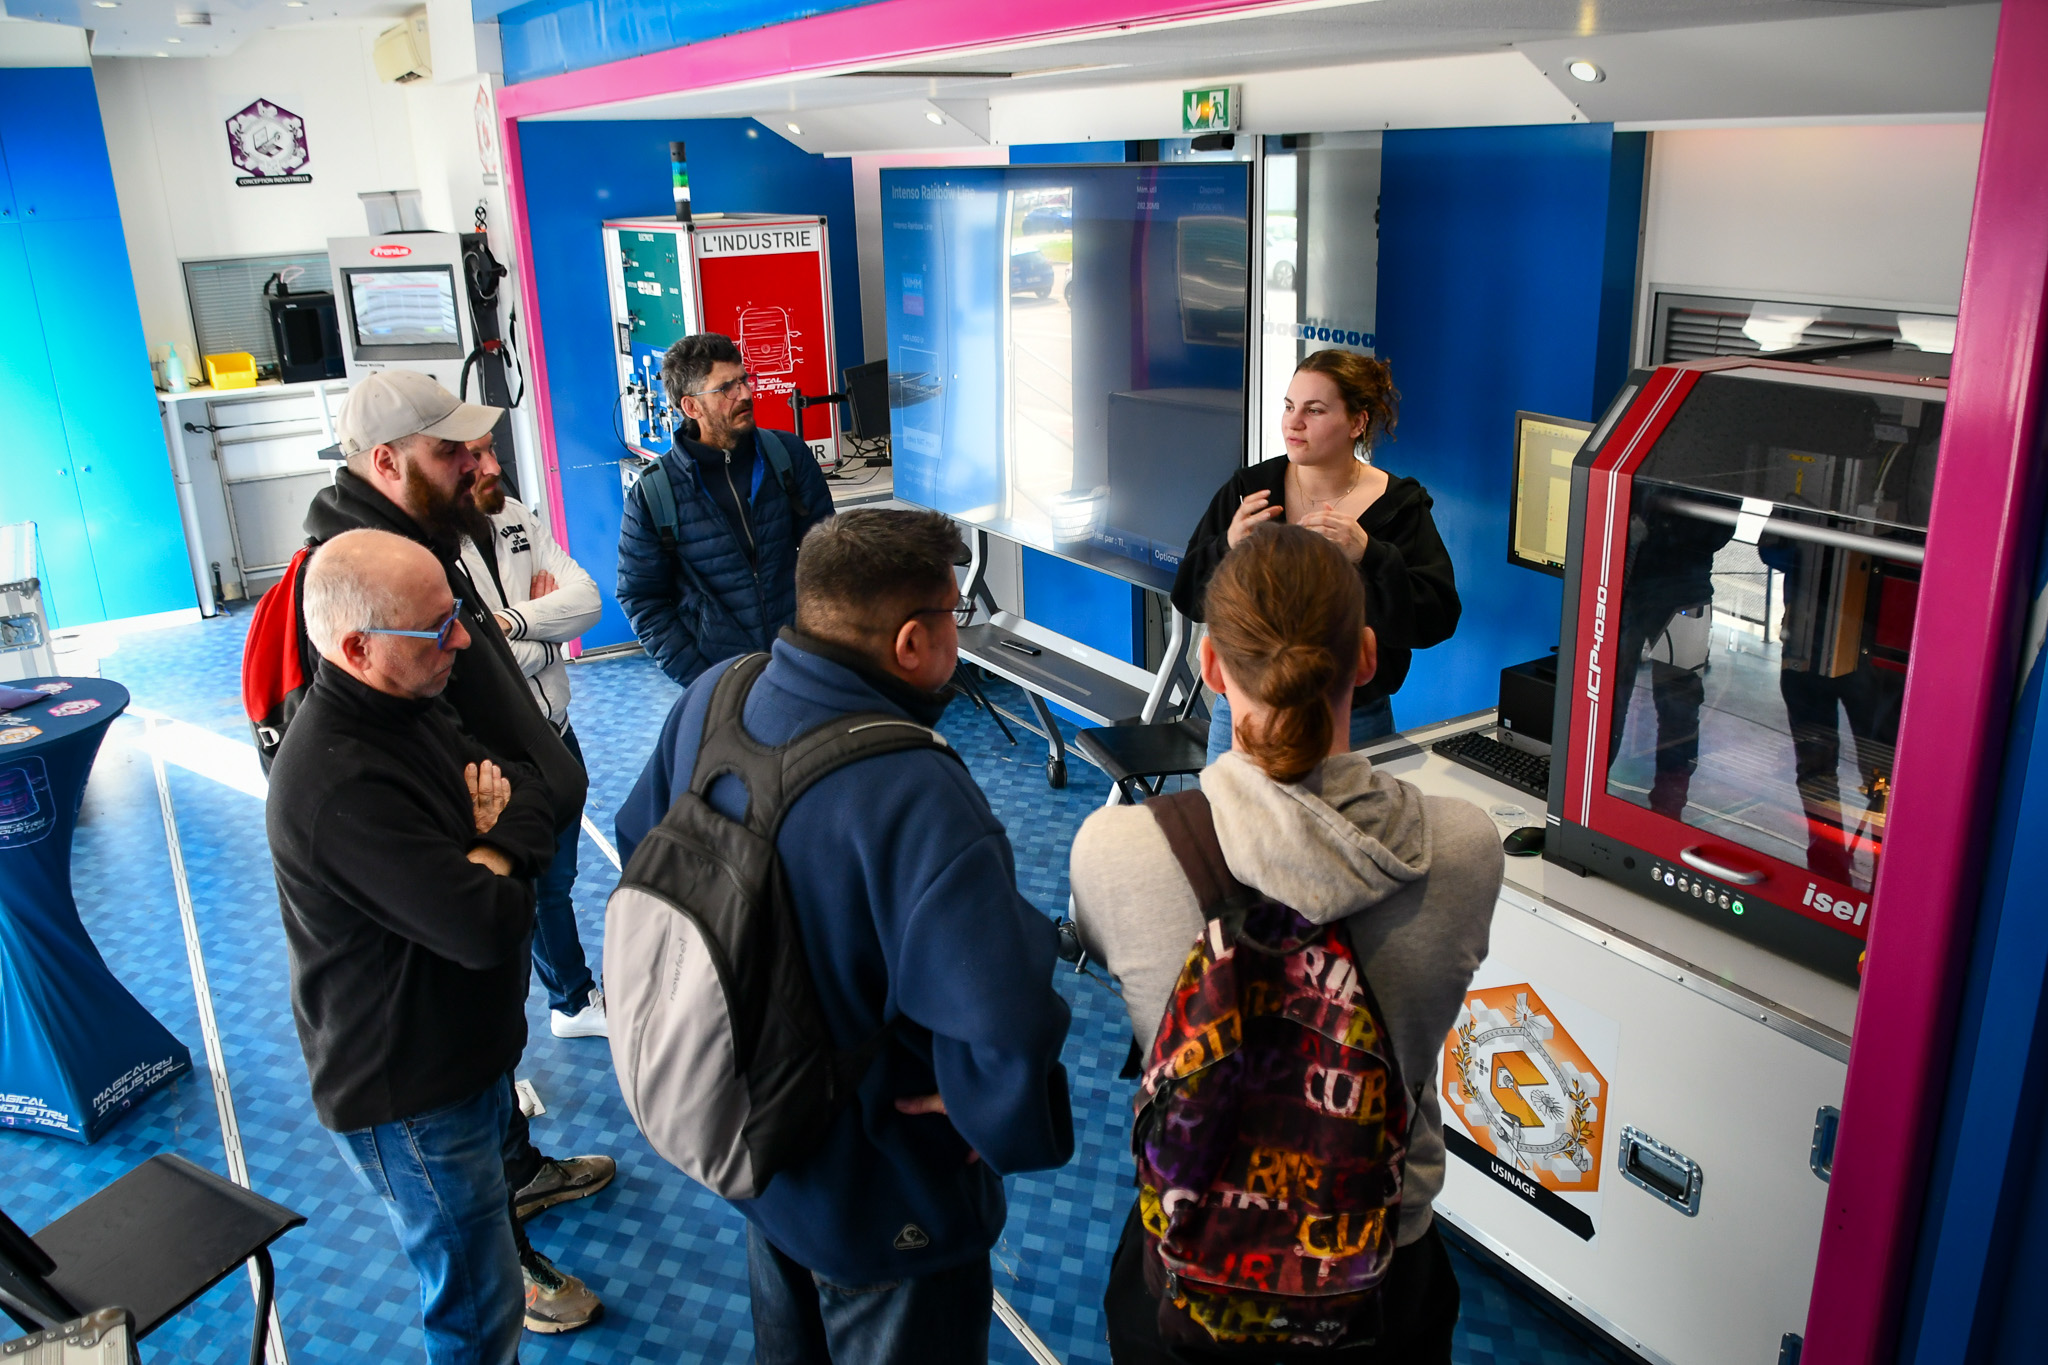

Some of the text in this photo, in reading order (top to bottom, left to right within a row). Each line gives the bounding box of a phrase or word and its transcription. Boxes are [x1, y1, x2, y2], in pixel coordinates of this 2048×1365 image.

[891, 185, 919, 200] Intenso
[921, 184, 955, 200] Rainbow
[702, 230, 811, 253] L'INDUSTRIE
[1154, 549, 1179, 565] Options
[1586, 585, 1608, 703] ICP4030
[1802, 882, 1868, 926] isel
[92, 1061, 151, 1109] MAGICAL
[97, 1055, 173, 1118] INDUSTRY
[144, 1063, 181, 1088] TOUR
[34, 1117, 75, 1132] TOUR
[1490, 1161, 1536, 1199] USINAGE
